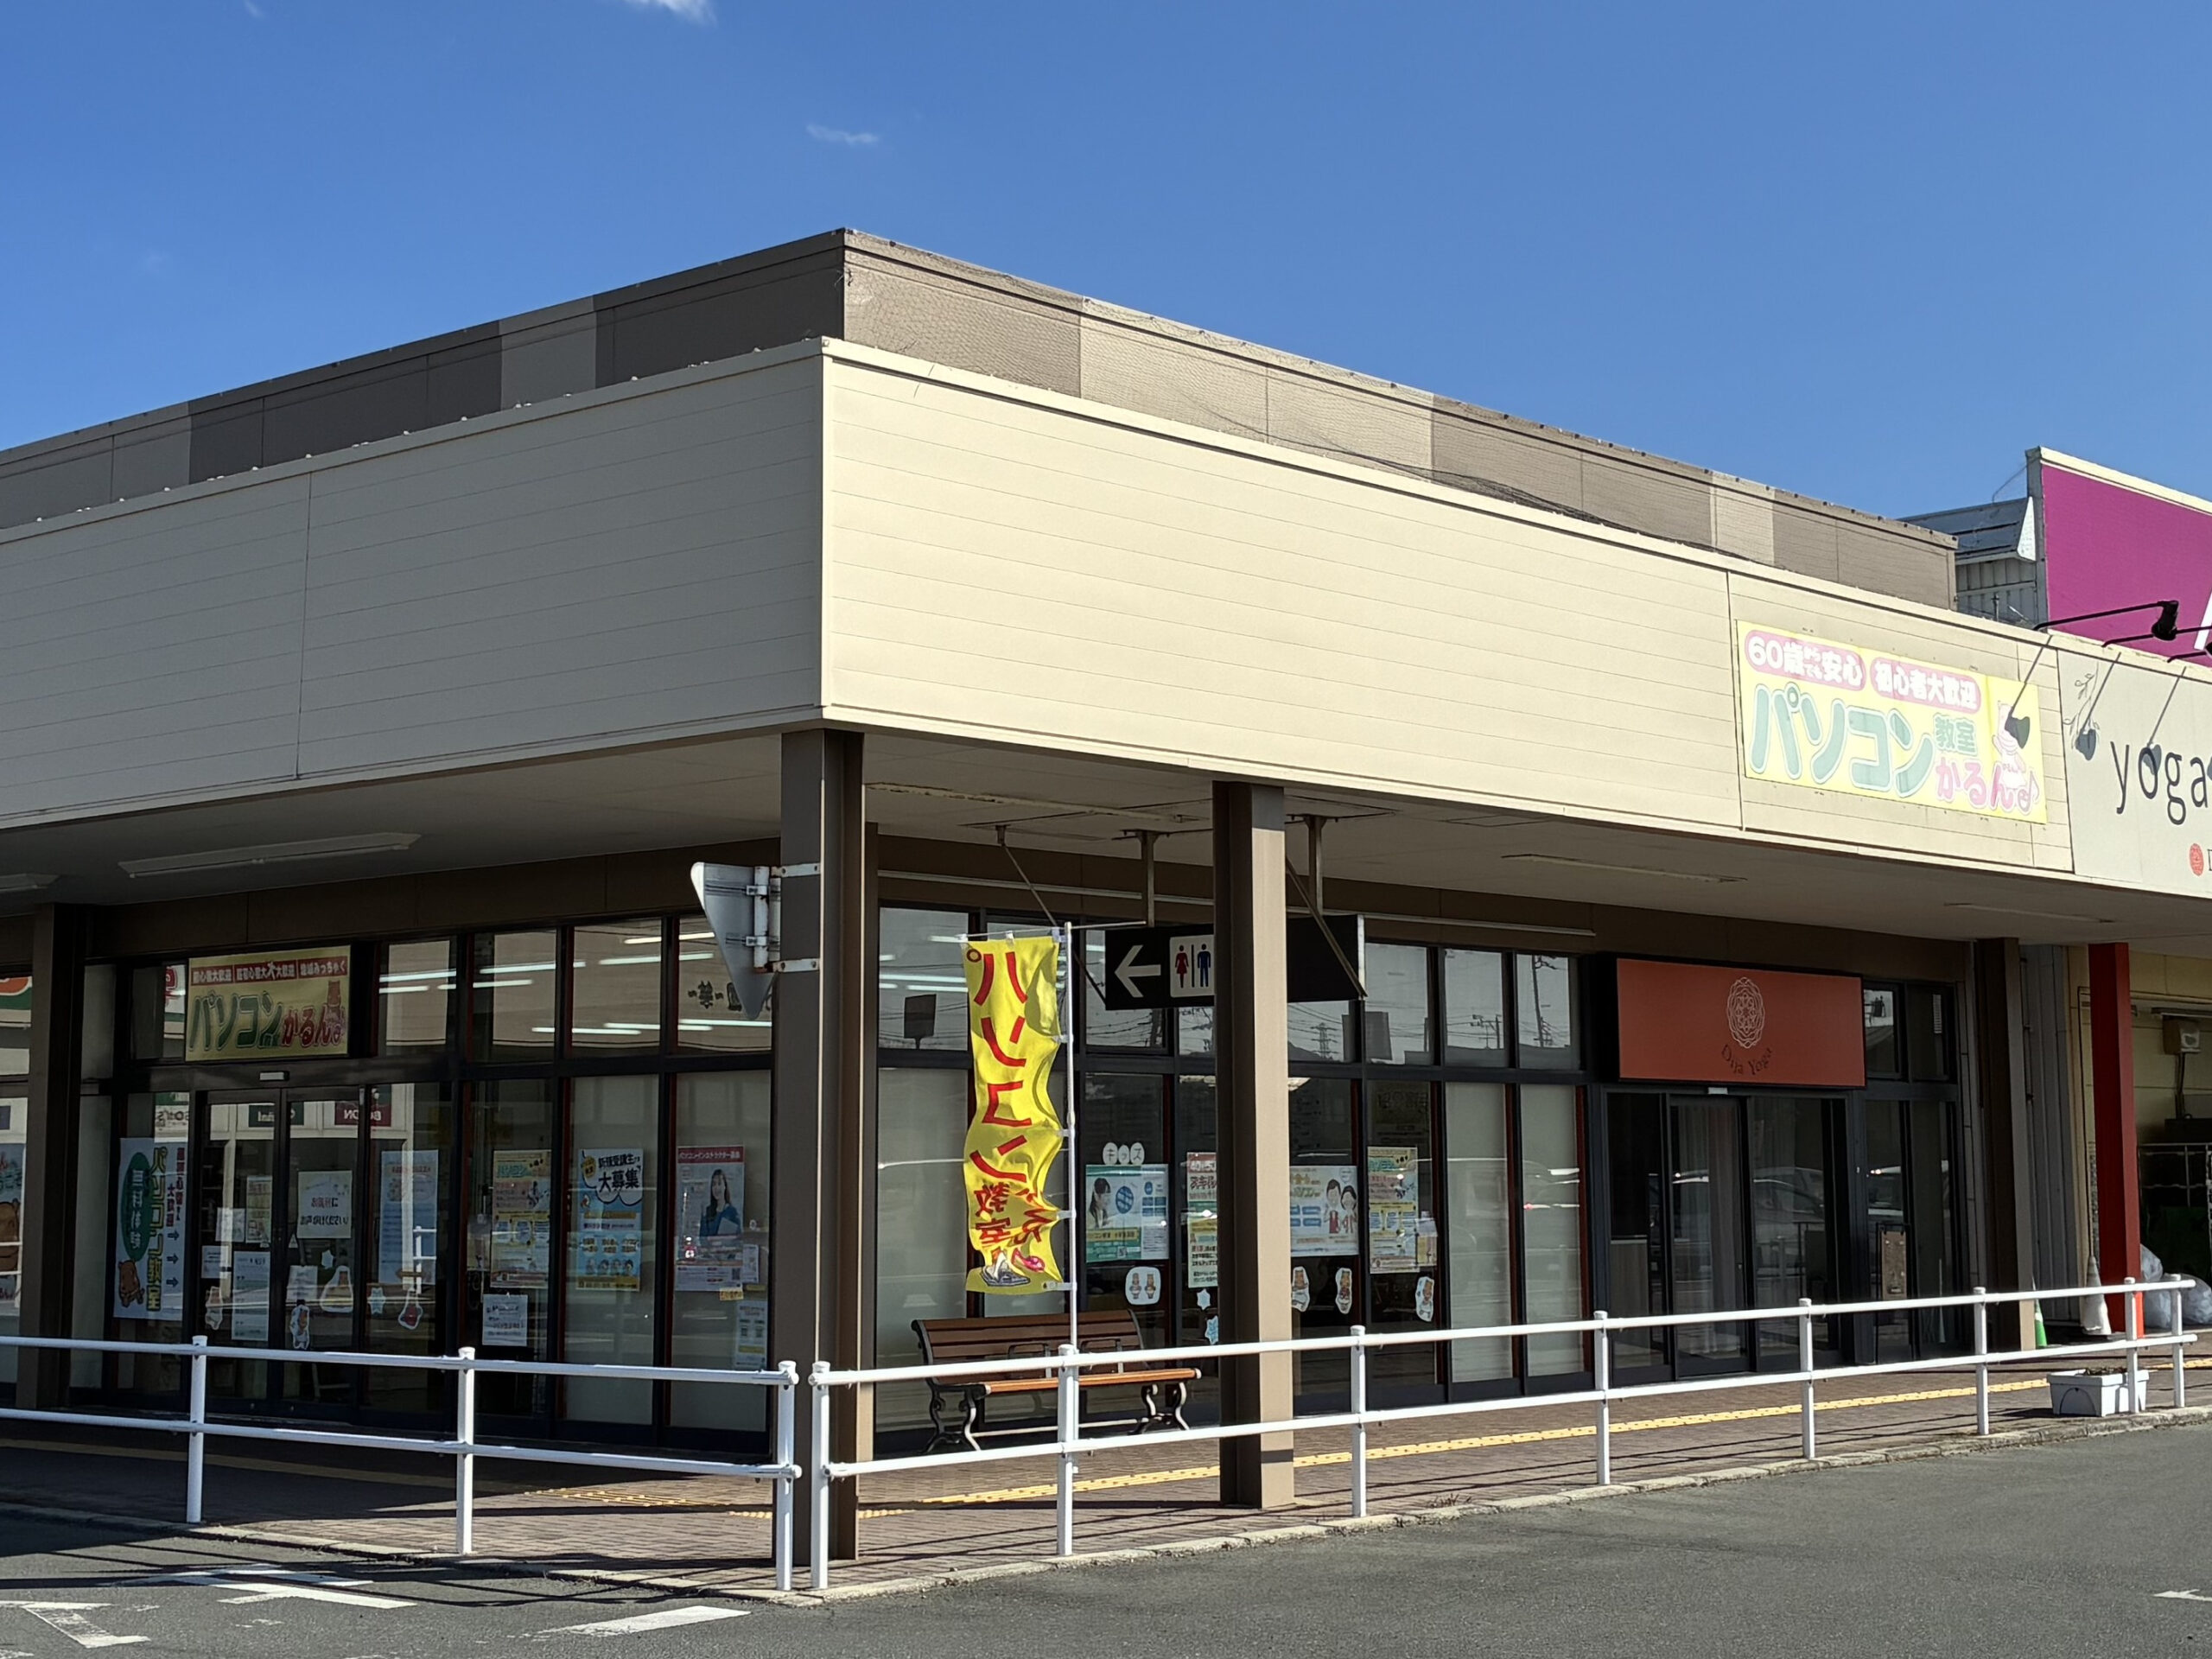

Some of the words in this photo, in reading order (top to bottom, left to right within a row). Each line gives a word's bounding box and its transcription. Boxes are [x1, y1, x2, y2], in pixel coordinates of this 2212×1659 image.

[1873, 660, 1979, 709] 初心者大歓迎
[1749, 682, 1936, 798] パソコン
[1933, 713, 1978, 756] 教室
[2109, 741, 2209, 826] yoga
[188, 990, 283, 1052] パソコン
[599, 1168, 639, 1192] 大募集
[147, 1146, 168, 1312] パソコン教室
